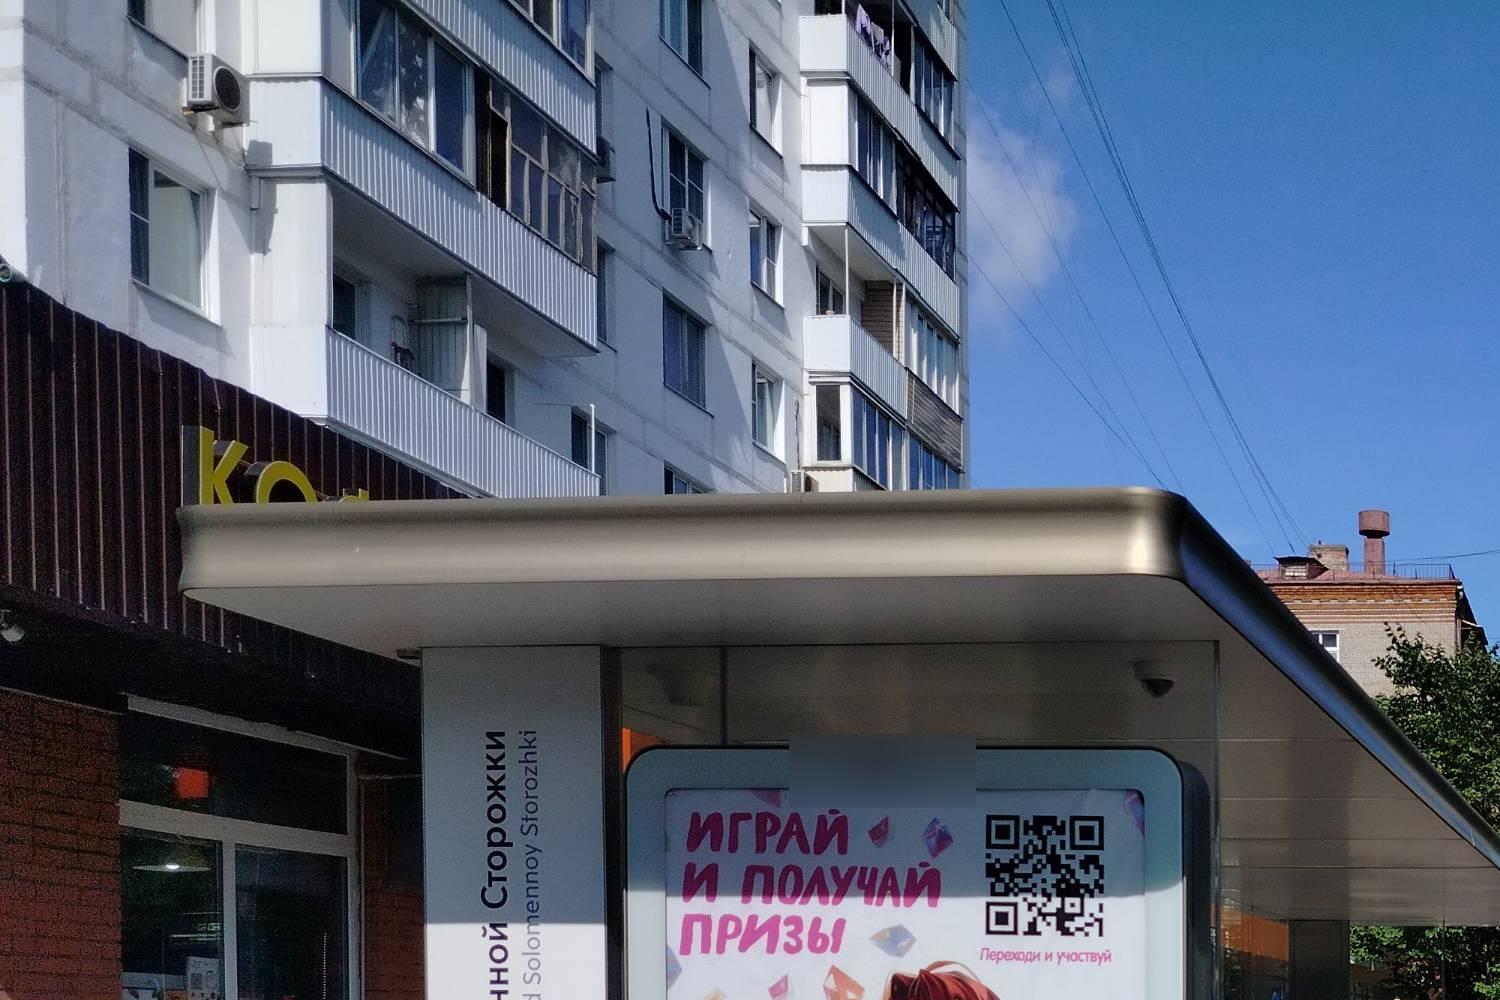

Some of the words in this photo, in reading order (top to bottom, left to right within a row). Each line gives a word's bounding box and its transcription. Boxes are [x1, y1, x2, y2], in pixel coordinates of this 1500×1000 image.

[518, 730, 538, 836] Storozhki
[480, 730, 513, 909] Сторожки
[686, 809, 849, 855] ИГРАЙ
[681, 862, 718, 904] И
[740, 861, 942, 908] ПОЛУЧАЙ
[521, 844, 542, 985] Solomennoy
[679, 913, 846, 956] ПРИЗЫ
[980, 948, 1041, 964] Переходи
[1044, 952, 1053, 963] и
[1056, 948, 1112, 966] участвуй
